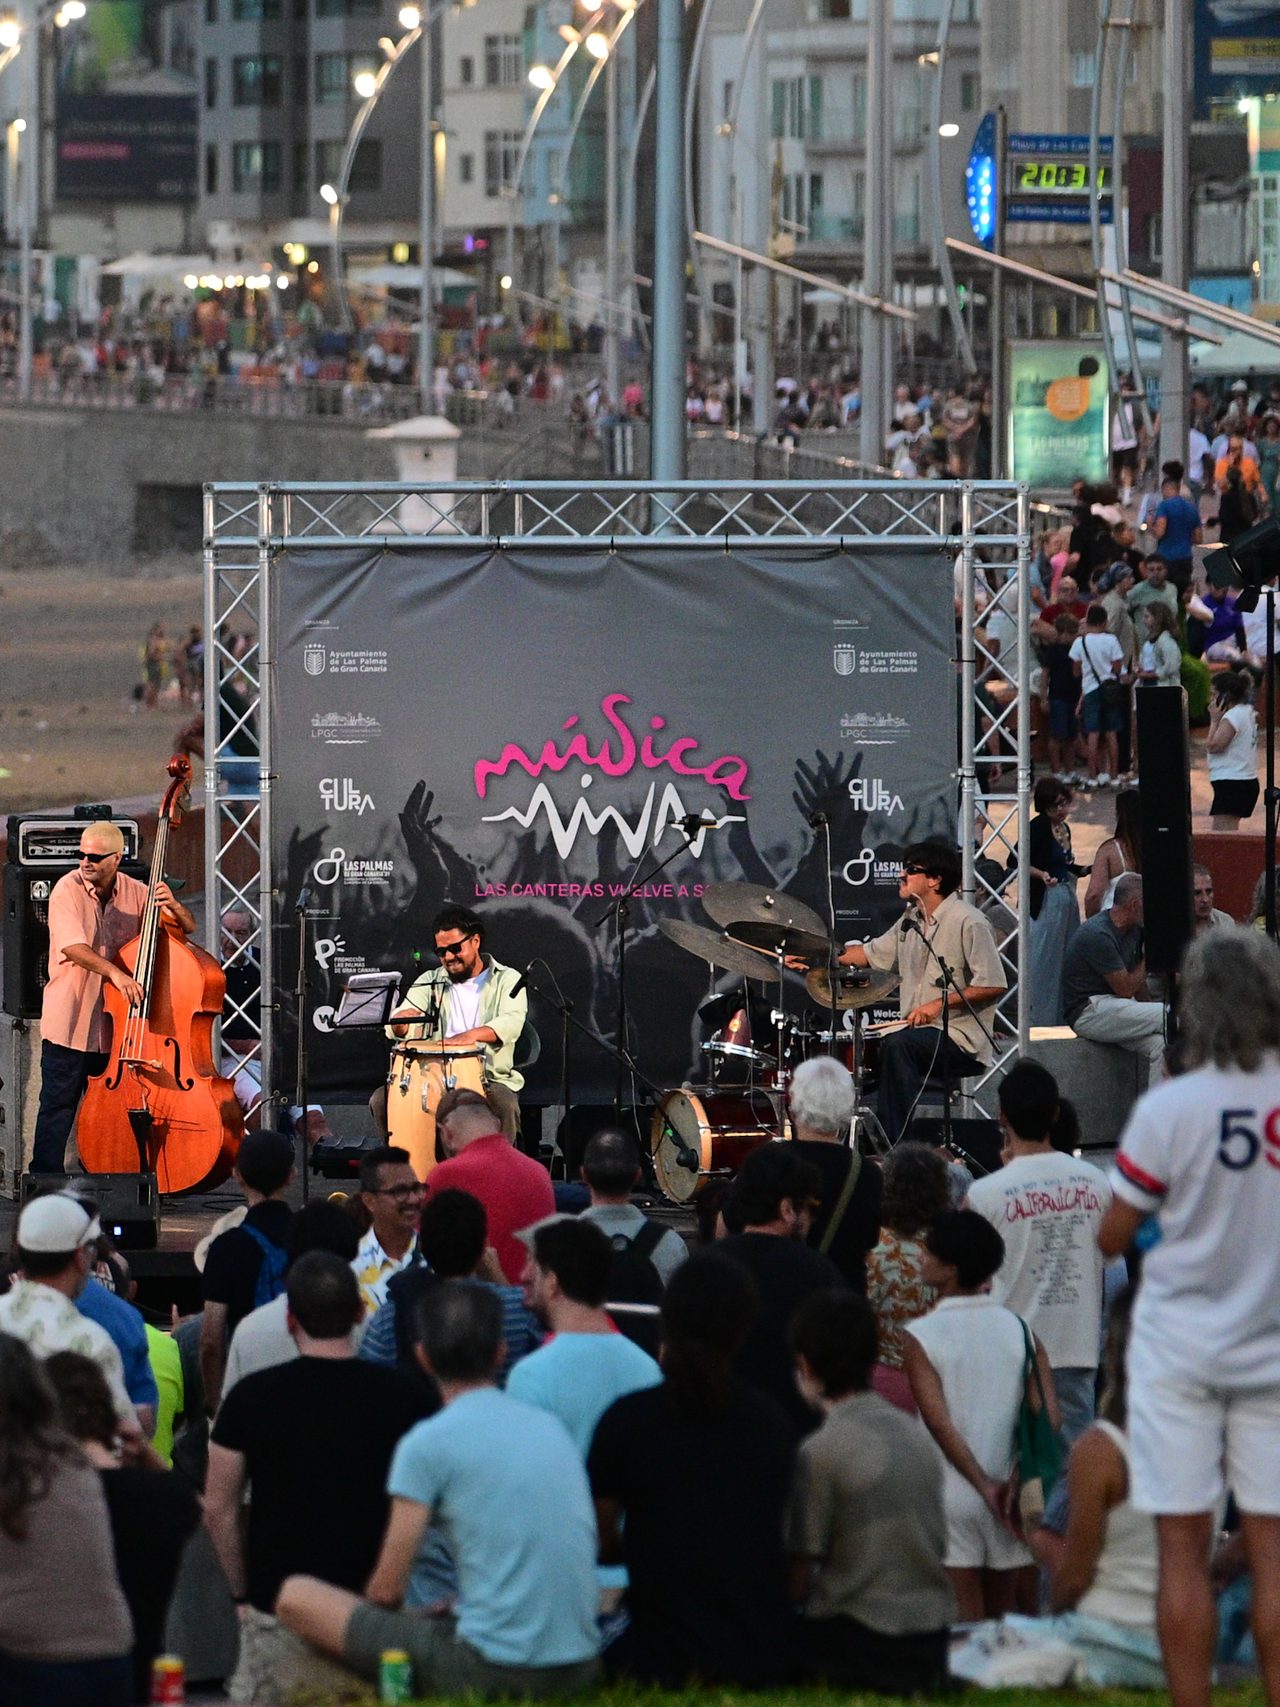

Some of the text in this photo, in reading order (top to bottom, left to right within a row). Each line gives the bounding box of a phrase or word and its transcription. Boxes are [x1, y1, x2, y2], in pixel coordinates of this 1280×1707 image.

[329, 650, 387, 658] Ayuntamiento
[859, 650, 917, 658] Ayuntamiento
[329, 665, 387, 673] de Gran Canaria
[859, 665, 917, 673] de Gran Canaria
[312, 729, 338, 738] LPGC
[840, 729, 868, 738] LPGC
[344, 861, 394, 871] LAS PALMAS
[874, 862, 889, 871] LAS
[475, 884, 506, 897] LAS
[511, 884, 604, 897] CANTERAS
[677, 884, 689, 897] A
